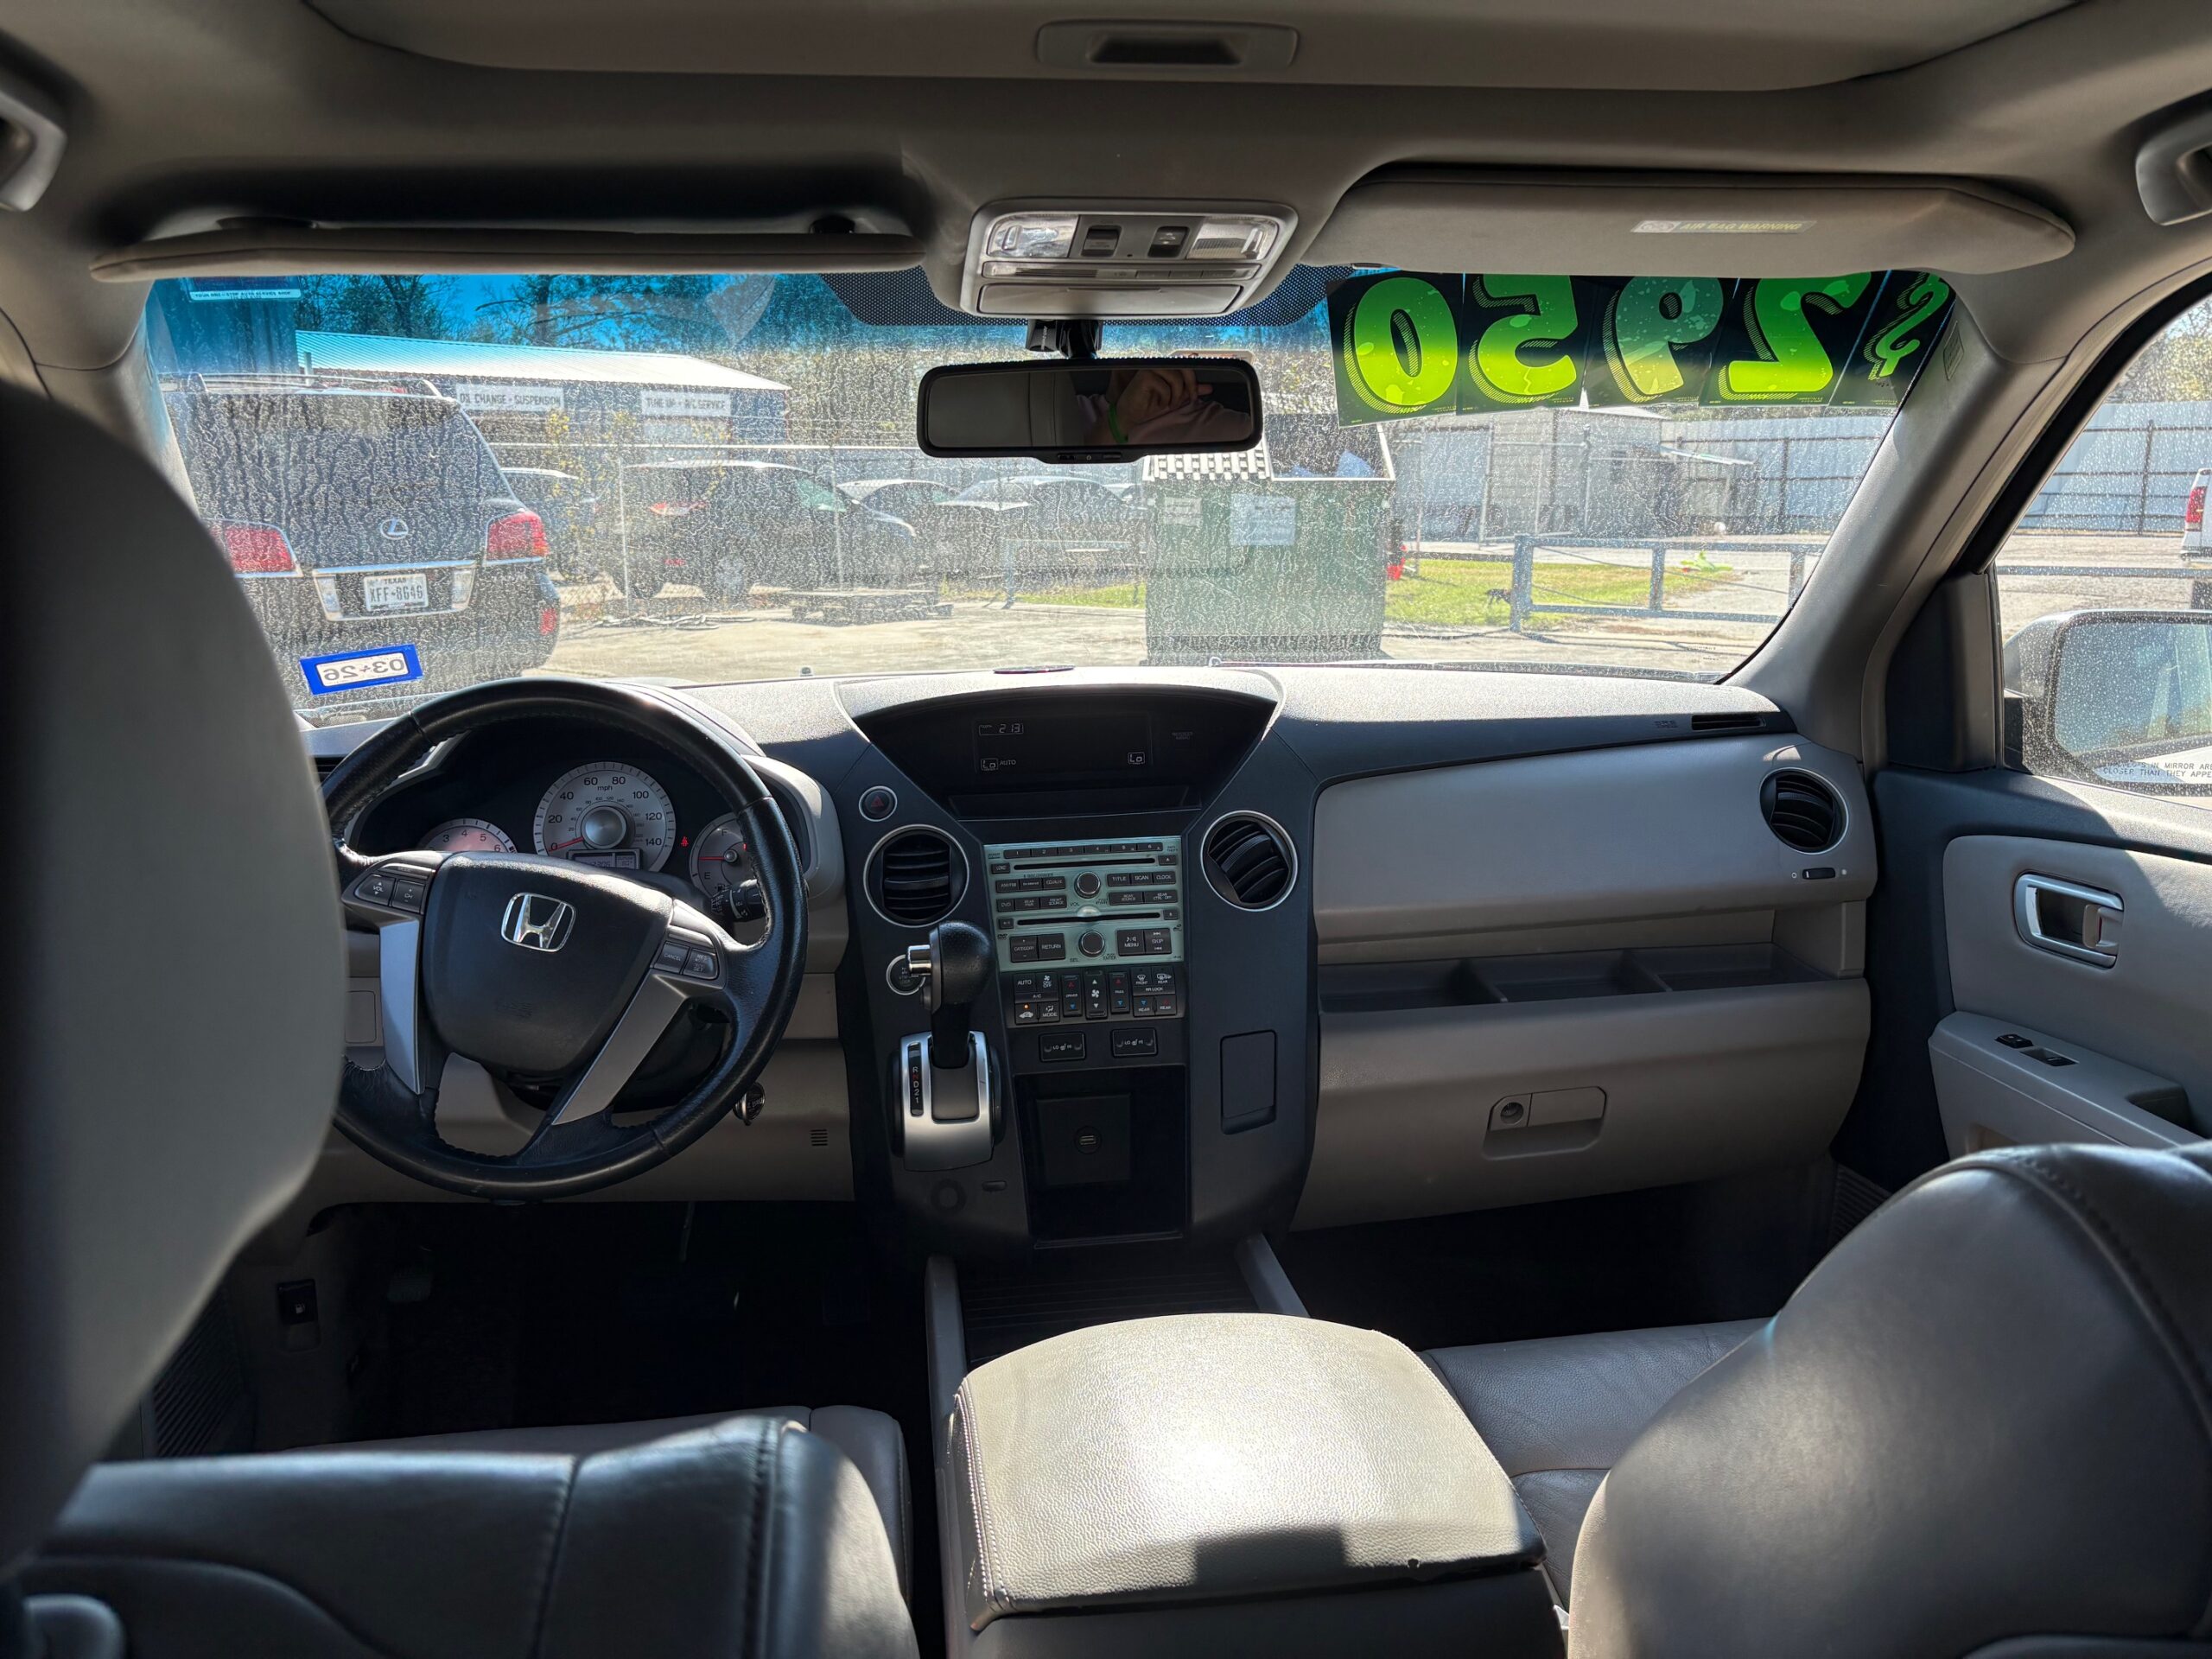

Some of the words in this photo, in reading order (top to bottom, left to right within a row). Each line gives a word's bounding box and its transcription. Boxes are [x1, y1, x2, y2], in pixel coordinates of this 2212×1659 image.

[474, 394, 506, 404] CHANGE
[583, 777, 598, 786] 60
[612, 776, 626, 785] 80
[559, 791, 574, 800] 40
[632, 791, 649, 799] 100
[548, 815, 563, 823] 20
[645, 812, 663, 821] 120
[664, 953, 681, 962] CANCEL
